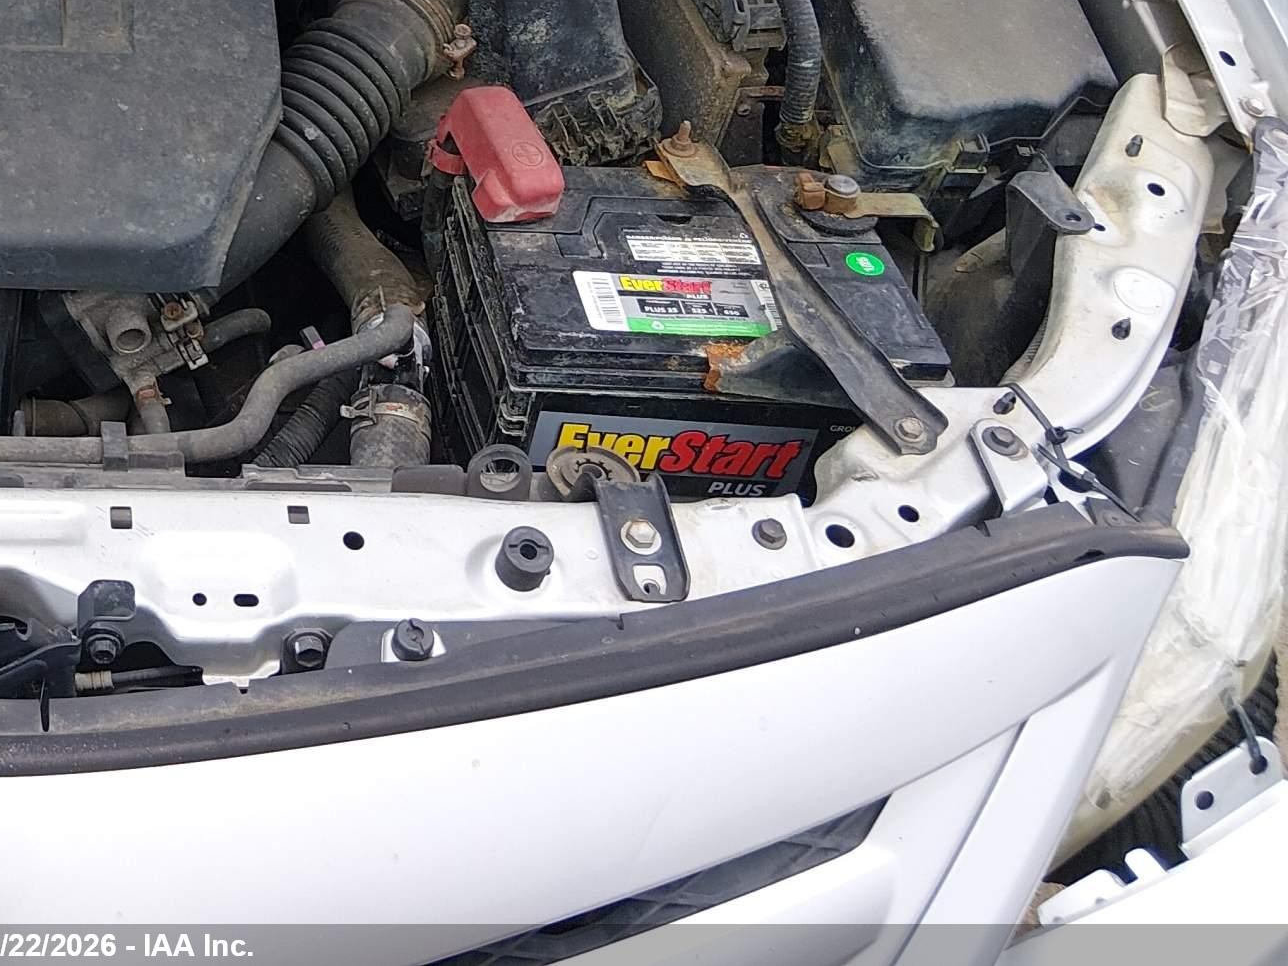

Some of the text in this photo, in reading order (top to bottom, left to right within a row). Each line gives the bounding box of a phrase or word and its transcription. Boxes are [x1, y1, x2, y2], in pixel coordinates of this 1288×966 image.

[619, 276, 712, 294] EverStart
[557, 423, 807, 480] EverStart
[708, 481, 766, 498] PLUS
